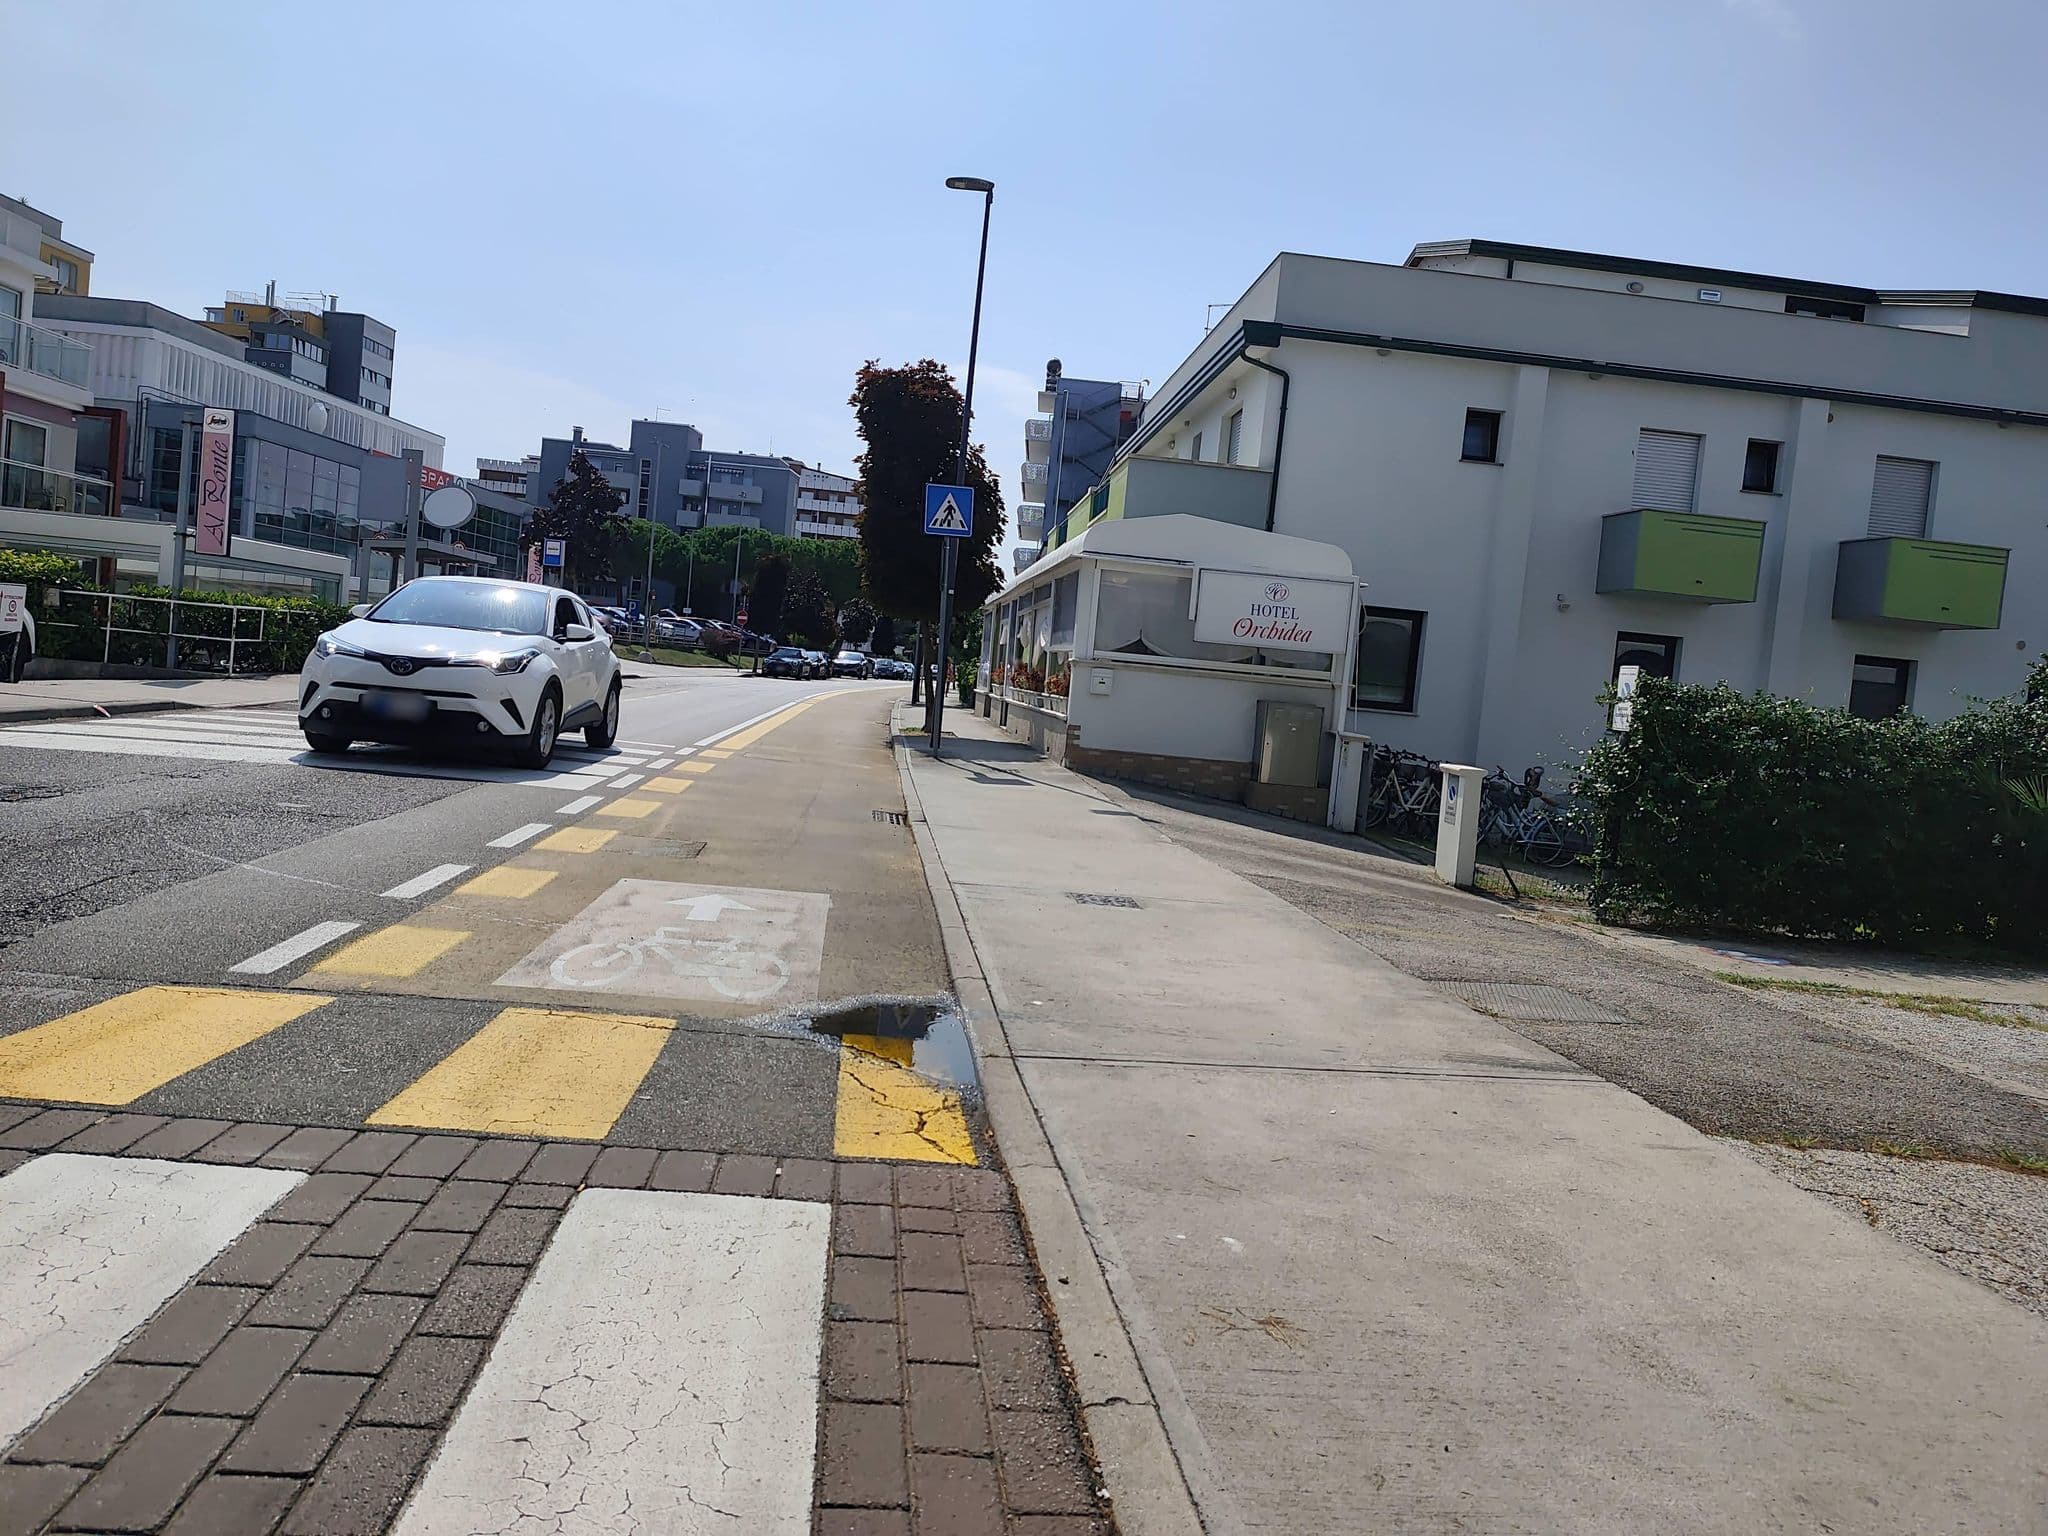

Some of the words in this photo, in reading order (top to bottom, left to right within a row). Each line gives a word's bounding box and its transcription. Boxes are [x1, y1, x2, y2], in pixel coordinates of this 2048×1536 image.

[200, 440, 229, 505] Ponte
[204, 512, 225, 546] Al
[630, 601, 637, 612] P
[1250, 604, 1300, 620] HOTEL
[1232, 617, 1313, 643] Orchidea
